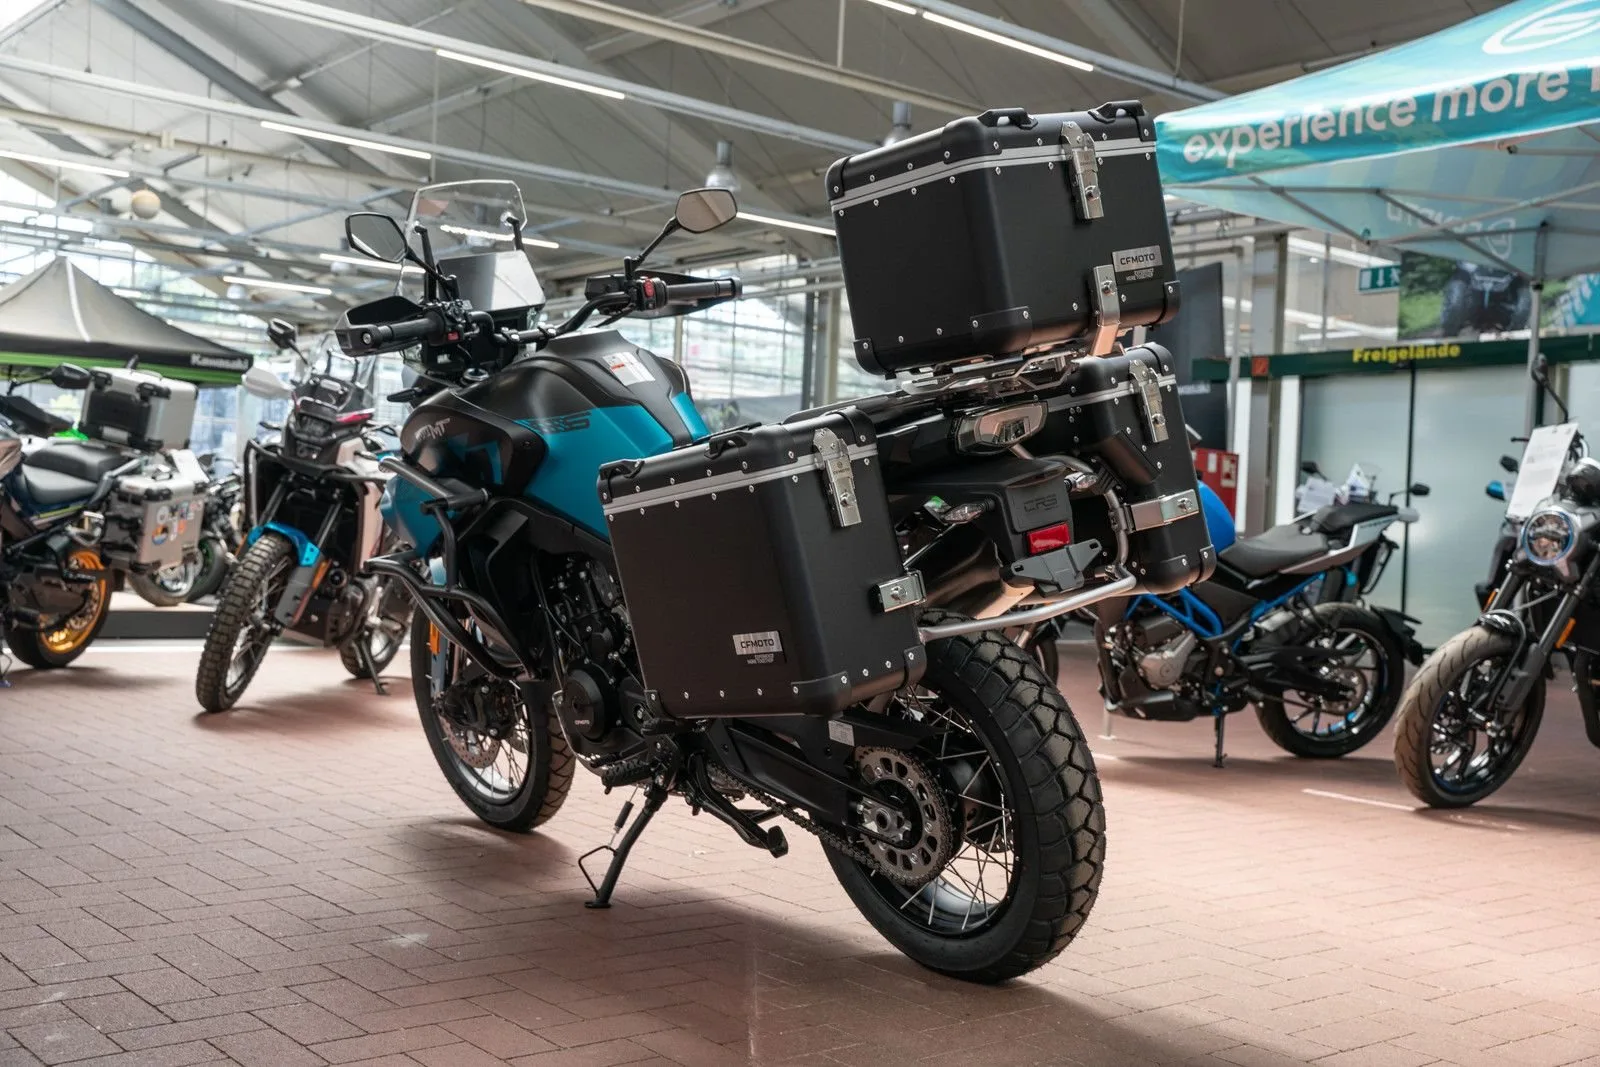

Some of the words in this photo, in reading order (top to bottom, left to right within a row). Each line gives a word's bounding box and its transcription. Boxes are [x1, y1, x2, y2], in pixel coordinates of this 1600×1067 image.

[1183, 98, 1417, 168] experience
[1432, 70, 1569, 122] more
[1120, 253, 1156, 265] CFMOTO
[191, 353, 249, 370] Kawasaki
[1352, 342, 1462, 364] Freigelände
[740, 638, 775, 649] CFMOTO
